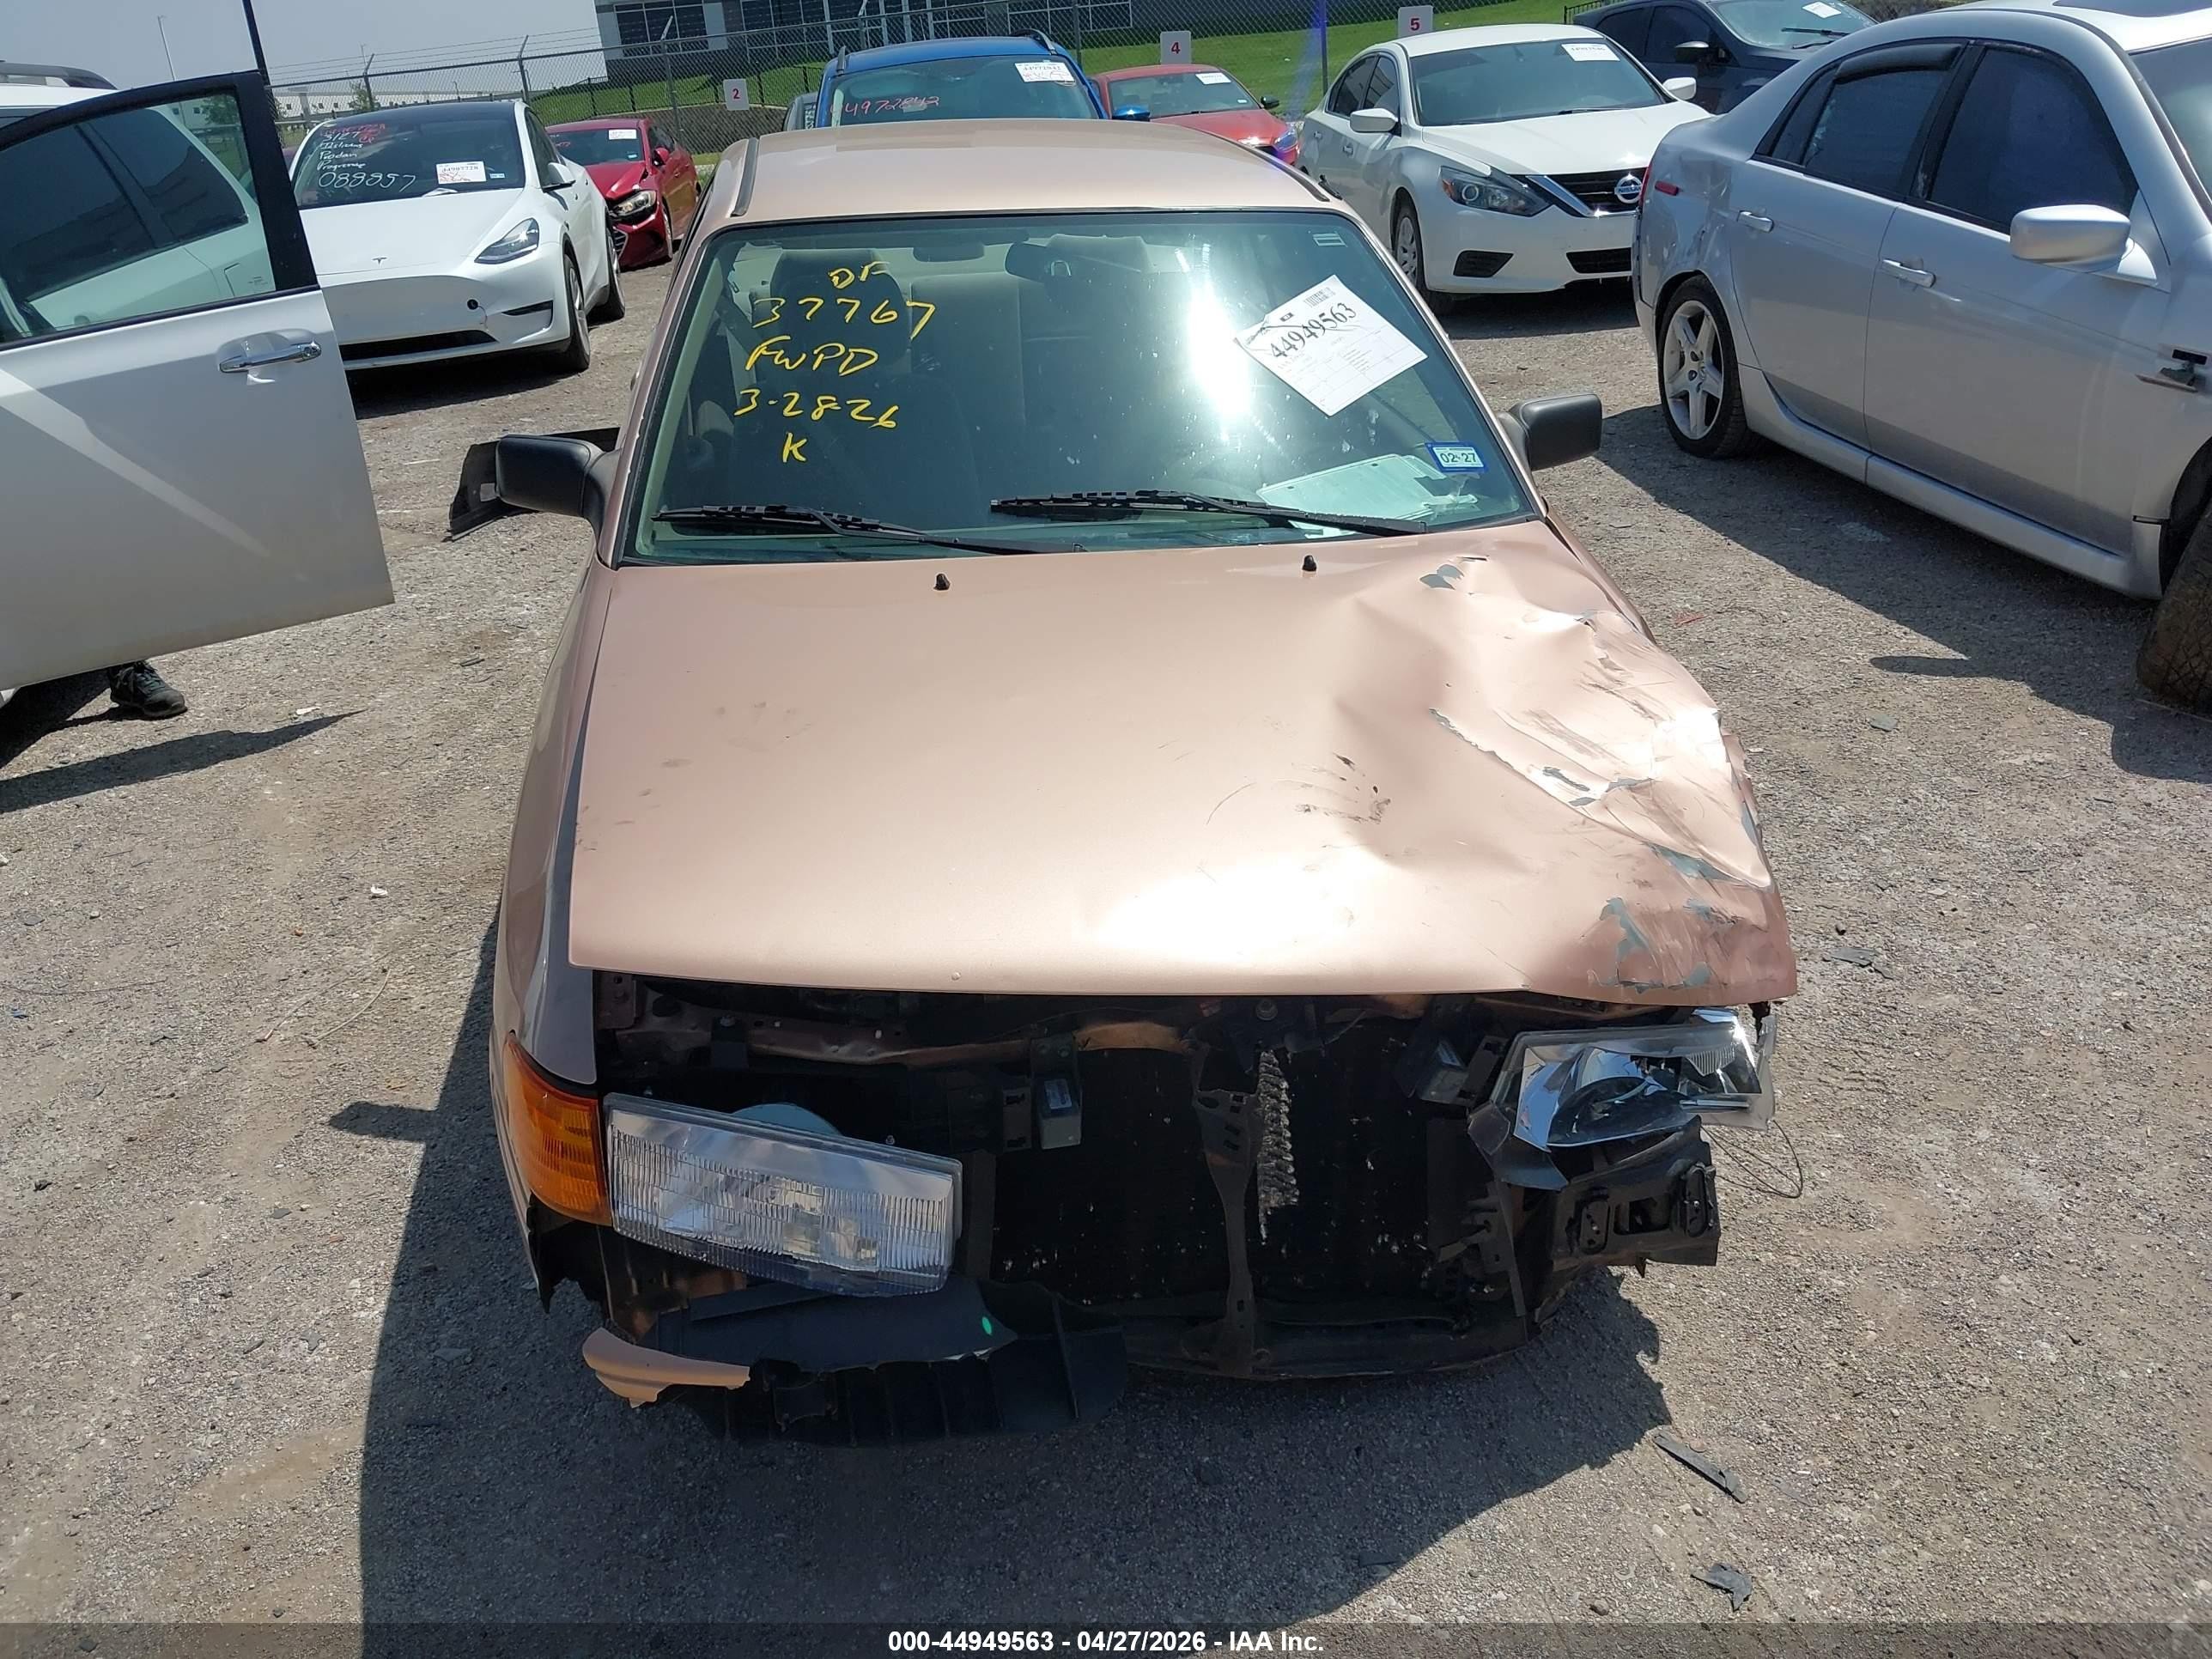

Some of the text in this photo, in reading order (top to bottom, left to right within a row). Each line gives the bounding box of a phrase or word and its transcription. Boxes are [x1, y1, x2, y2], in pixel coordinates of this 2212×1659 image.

[1410, 17, 1420, 31] 5
[1170, 41, 1181, 54] 4
[732, 88, 741, 100] 2
[752, 297, 936, 341] 37767
[1271, 302, 1357, 358] 44949563
[782, 432, 808, 463] K
